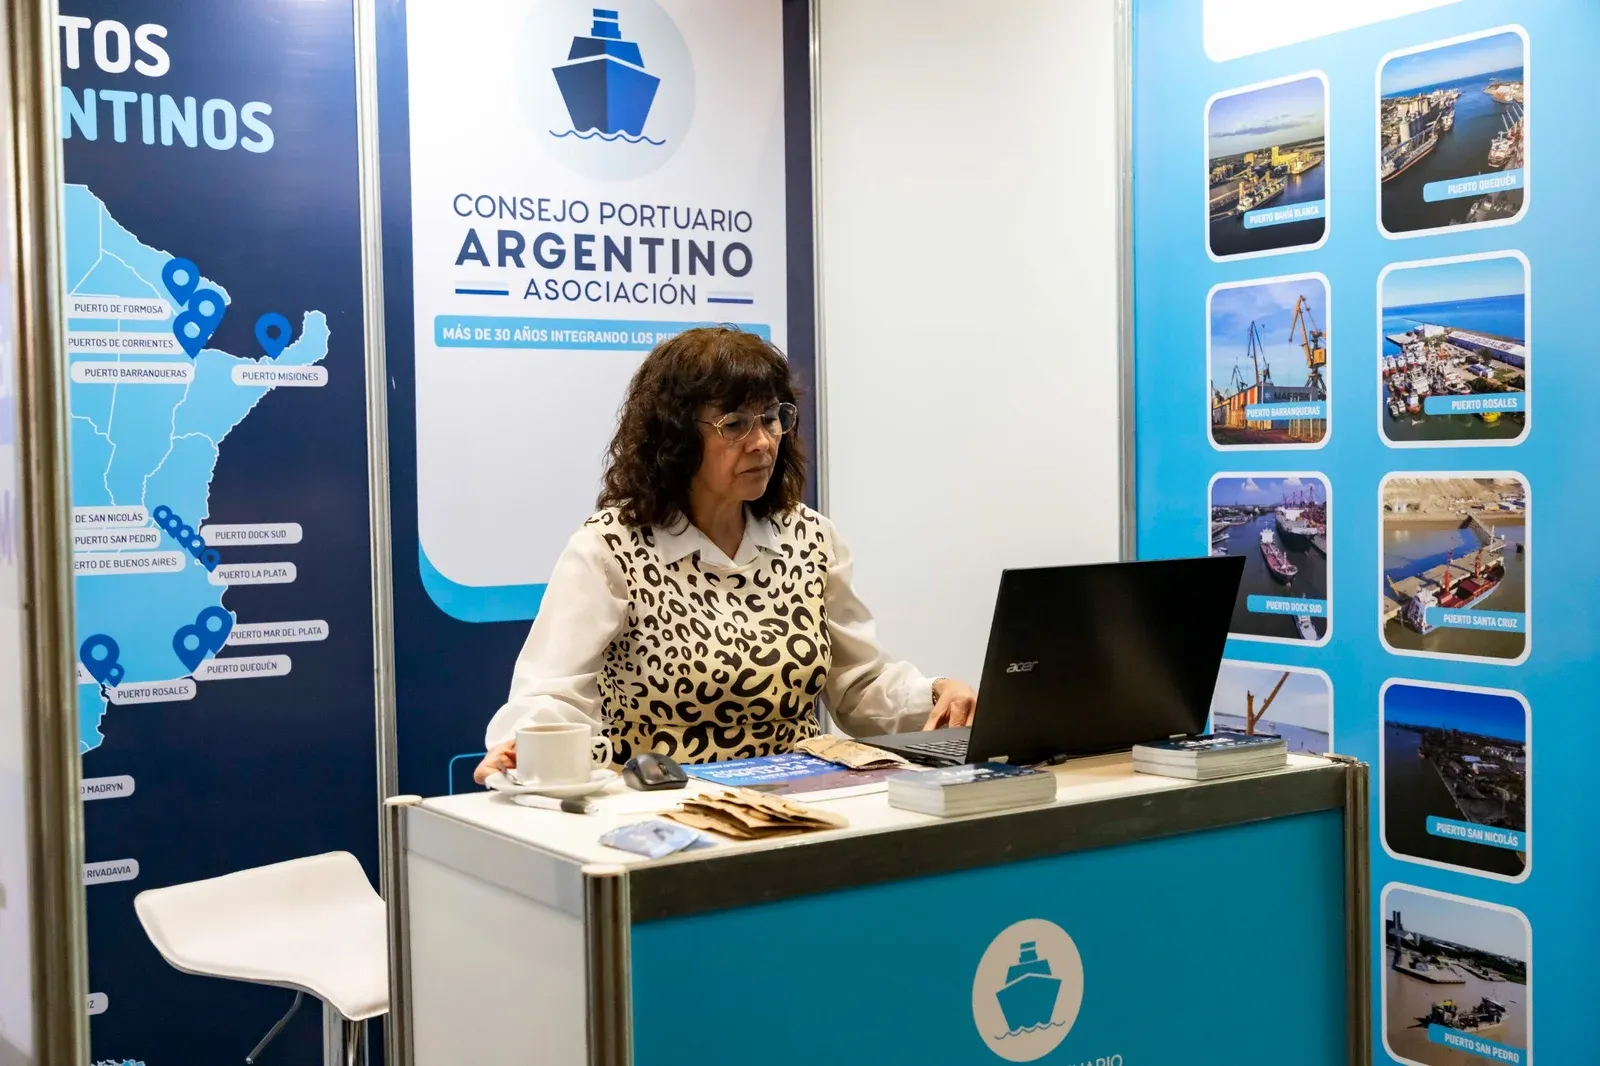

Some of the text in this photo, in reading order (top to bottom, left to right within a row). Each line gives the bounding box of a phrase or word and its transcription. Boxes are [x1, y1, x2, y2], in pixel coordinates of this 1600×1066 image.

[1447, 174, 1517, 195] PUERTO QUEQUÉN
[453, 193, 753, 233] CONSEJO PORTUARIO
[1249, 205, 1319, 224] PUERTO BAHÍA BLANCA
[454, 228, 754, 278] ARGENTINO
[523, 278, 697, 305] ASOCIACIÓN
[74, 303, 164, 314] PUERTO DE FORMOSA
[443, 323, 473, 341] MÁS
[475, 327, 492, 341] DE
[494, 328, 511, 342] 30
[513, 325, 548, 342] AÑOS
[551, 330, 628, 345] INTEGRANDO
[631, 331, 653, 345] LOS
[68, 338, 174, 348] PUERTOS DE CORRIENTES
[84, 368, 188, 378] PUERTO BARRANQUERAS
[242, 371, 319, 382] PUERTO MISIONES
[1451, 397, 1518, 411] PUERTO ROSALES
[1247, 406, 1321, 418] PUERTO BARRANQUERAS
[75, 512, 143, 523] DE SAN NICOLÁS
[74, 534, 157, 545] PUERTO SAN PEDRO
[215, 528, 287, 540] PUERTO DOCK SUD
[99, 560, 112, 569] DE
[113, 558, 150, 568] BUENOS
[151, 557, 177, 567] AIRES
[218, 568, 287, 579] PUERTO LA PLATA
[1265, 600, 1322, 614] PUERTO DOCK SUD
[1443, 613, 1518, 628] PUERTO SANTA CRUZ
[231, 626, 322, 639] PUERTO MAR DEL PLATA
[207, 661, 278, 674] PUERTO QUEQUÉN
[1006, 661, 1039, 673] acer
[117, 686, 189, 699] PUERTO ROSALES
[87, 782, 124, 794] MADRYN
[1436, 822, 1519, 847] PUERTO SAN NICOLÁS
[86, 865, 131, 878] RIVADAVIA
[1444, 1032, 1520, 1064] PUERTO SAN PEDRO
